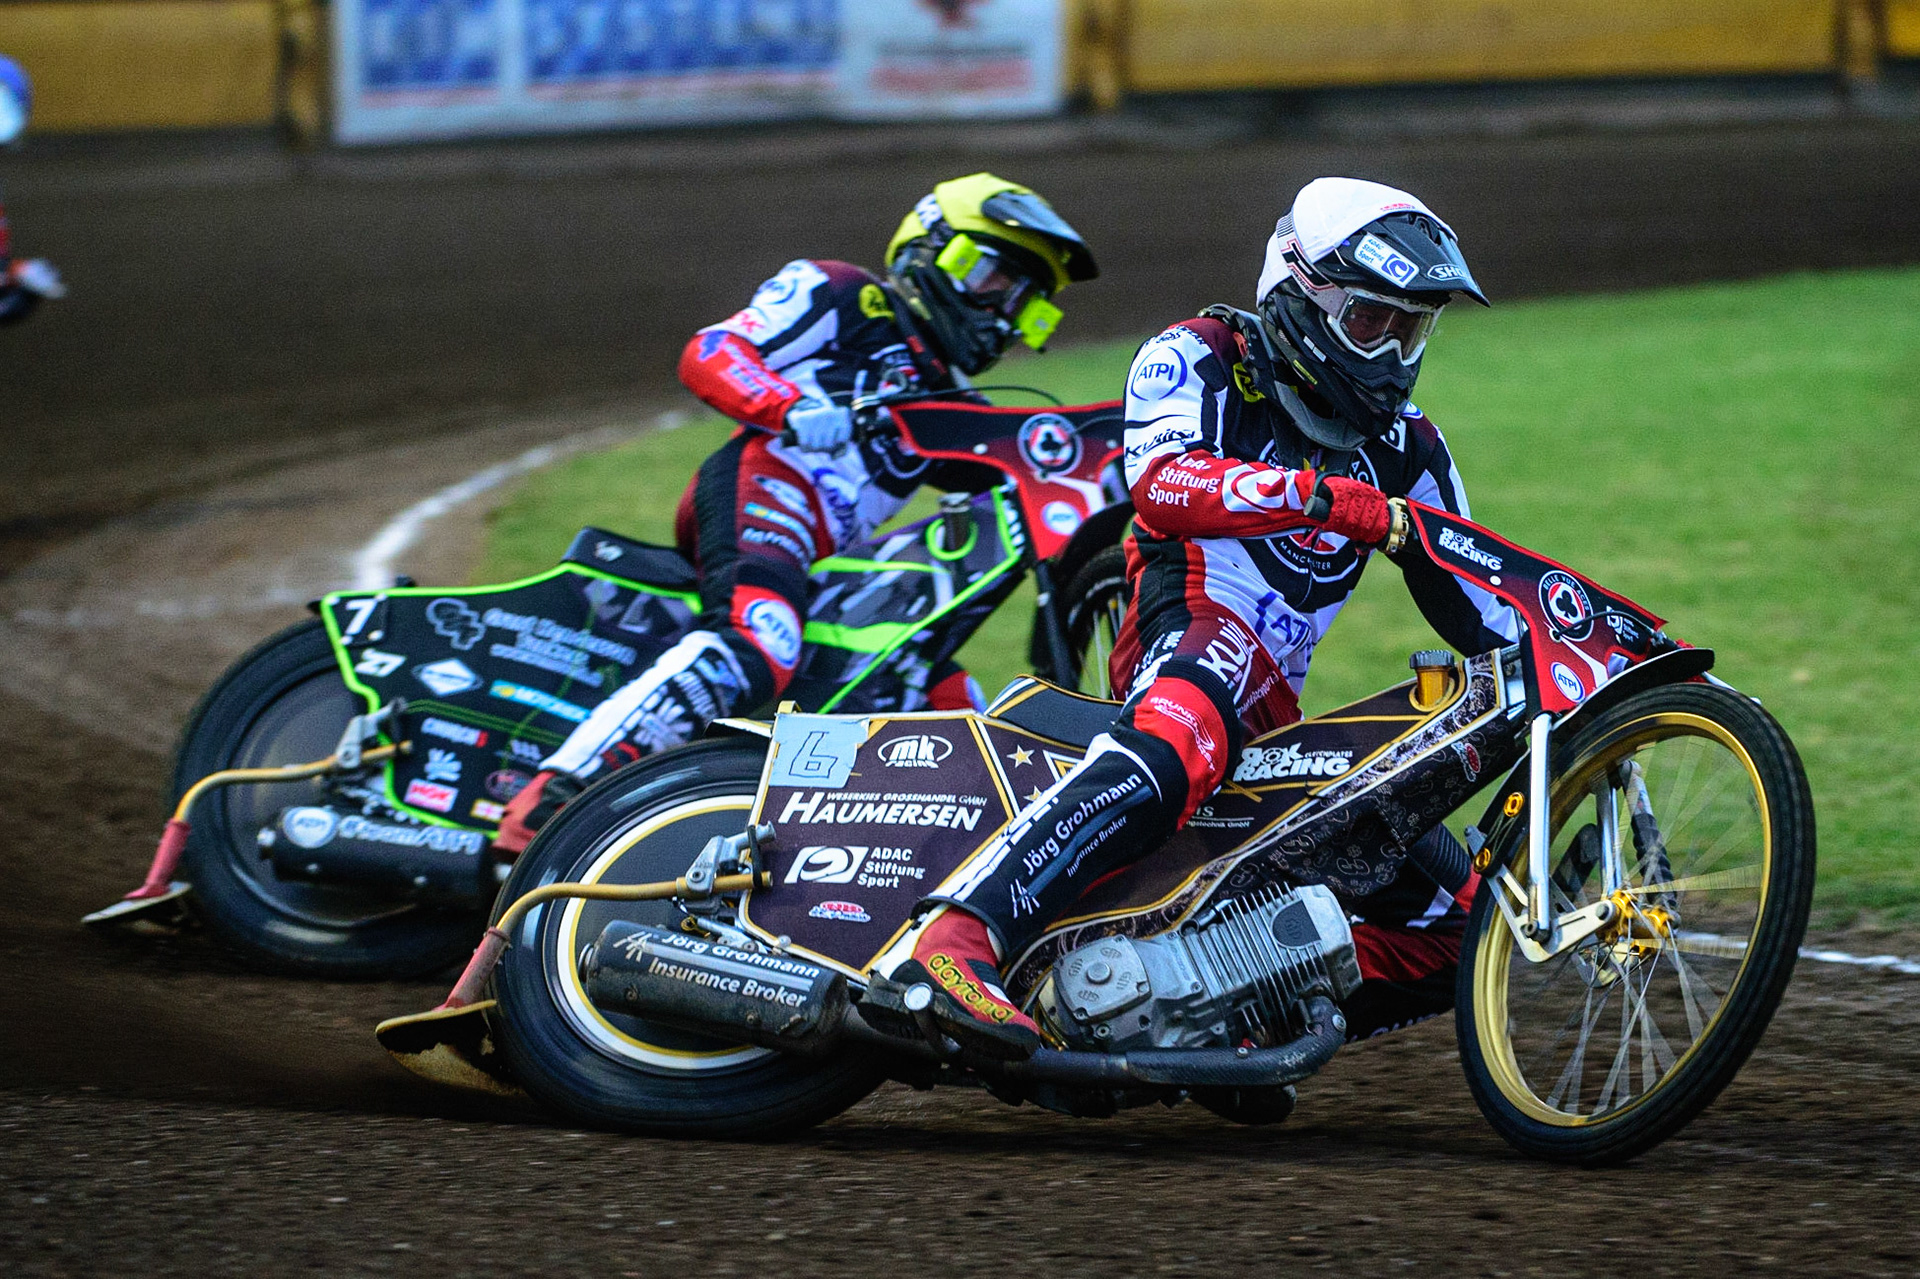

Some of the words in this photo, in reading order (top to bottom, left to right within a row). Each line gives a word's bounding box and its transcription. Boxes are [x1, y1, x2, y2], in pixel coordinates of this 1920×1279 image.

[1137, 362, 1175, 381] ATPI
[1157, 466, 1221, 493] Stiftung
[1147, 482, 1190, 507] Sport
[1438, 533, 1502, 571] RACING
[346, 598, 378, 635] 7
[1558, 673, 1578, 691] ATPI
[788, 730, 839, 779] 6
[1232, 757, 1350, 782] RACING
[883, 792, 956, 803] GROSSHANDEL
[777, 792, 983, 832] HAUMERSEN
[1022, 836, 1060, 876] Jörg
[1055, 773, 1142, 840] Grohmann
[1098, 815, 1128, 843] Broker
[871, 847, 913, 861] ADAC
[857, 873, 900, 889] Sport
[864, 860, 926, 880] Stiftung
[662, 932, 710, 955] Jörg
[711, 943, 821, 979] Grohmann
[648, 956, 739, 993] Insurance
[741, 979, 808, 1008] Broker
[927, 951, 1016, 1025] daytona
